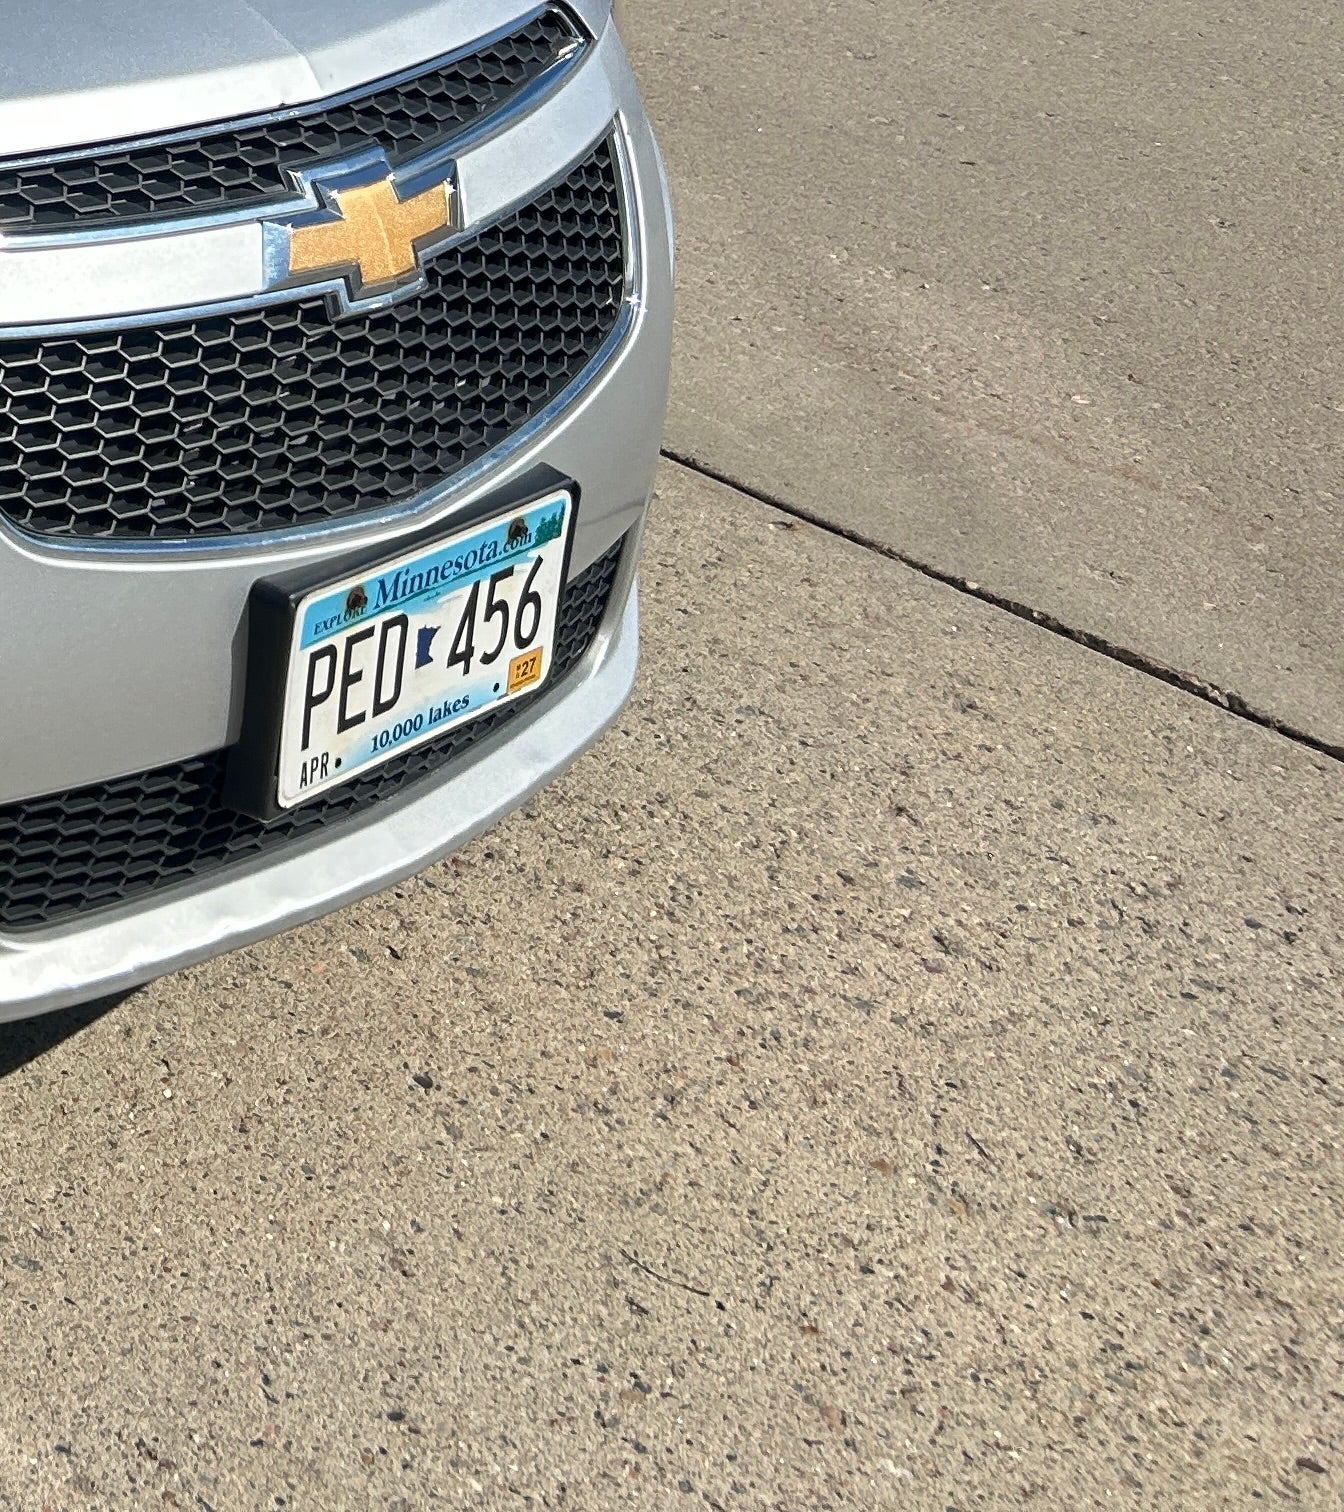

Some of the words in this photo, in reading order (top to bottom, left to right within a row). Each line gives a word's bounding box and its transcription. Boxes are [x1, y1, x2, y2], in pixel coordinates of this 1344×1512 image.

[300, 613, 409, 752] PED
[446, 554, 544, 677] 456
[520, 656, 537, 678] 27
[370, 713, 424, 754] 10,000
[427, 694, 470, 725] lakes
[299, 751, 330, 789] APR
